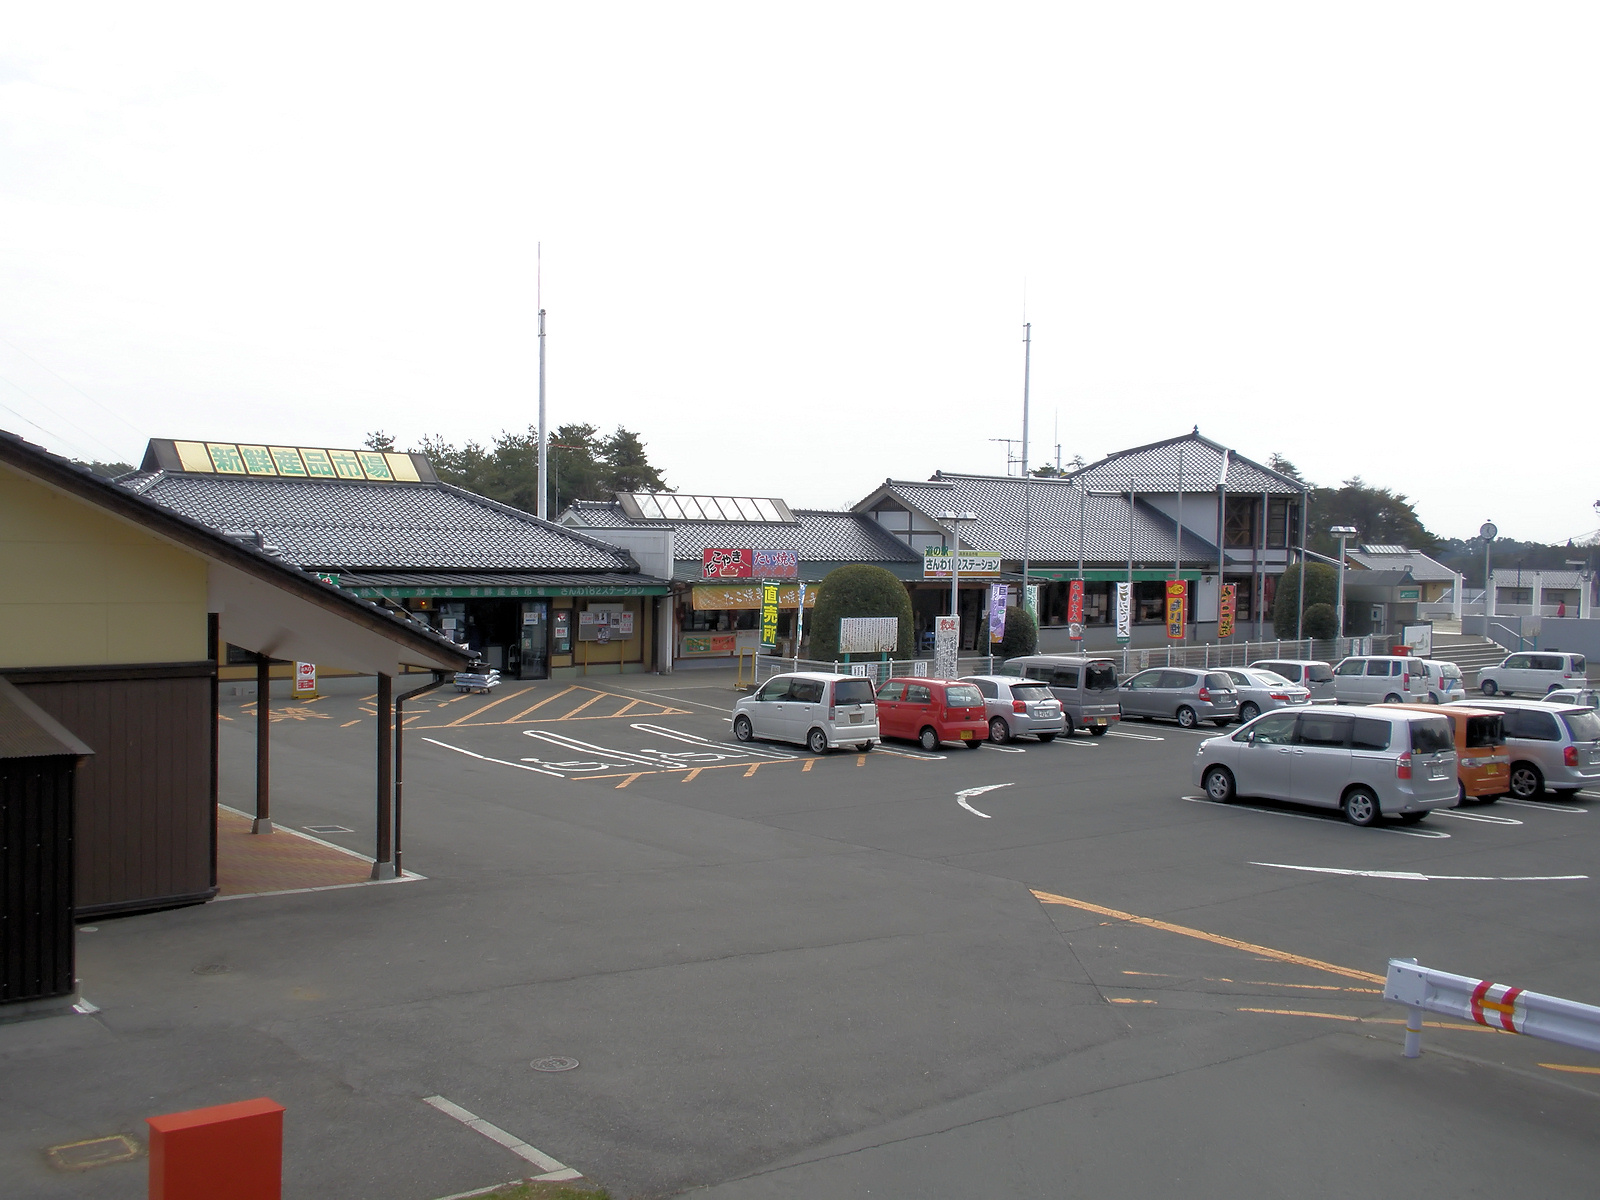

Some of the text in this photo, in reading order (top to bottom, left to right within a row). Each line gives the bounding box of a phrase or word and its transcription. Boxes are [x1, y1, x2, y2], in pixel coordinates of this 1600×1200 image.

[211, 446, 390, 478] 新鮮産品市場
[754, 550, 797, 567] たい焼き
[925, 545, 949, 557] 道の駅
[704, 549, 742, 576] たこやき
[560, 586, 645, 596] さんわ182ステーション
[763, 585, 779, 644] 直売所
